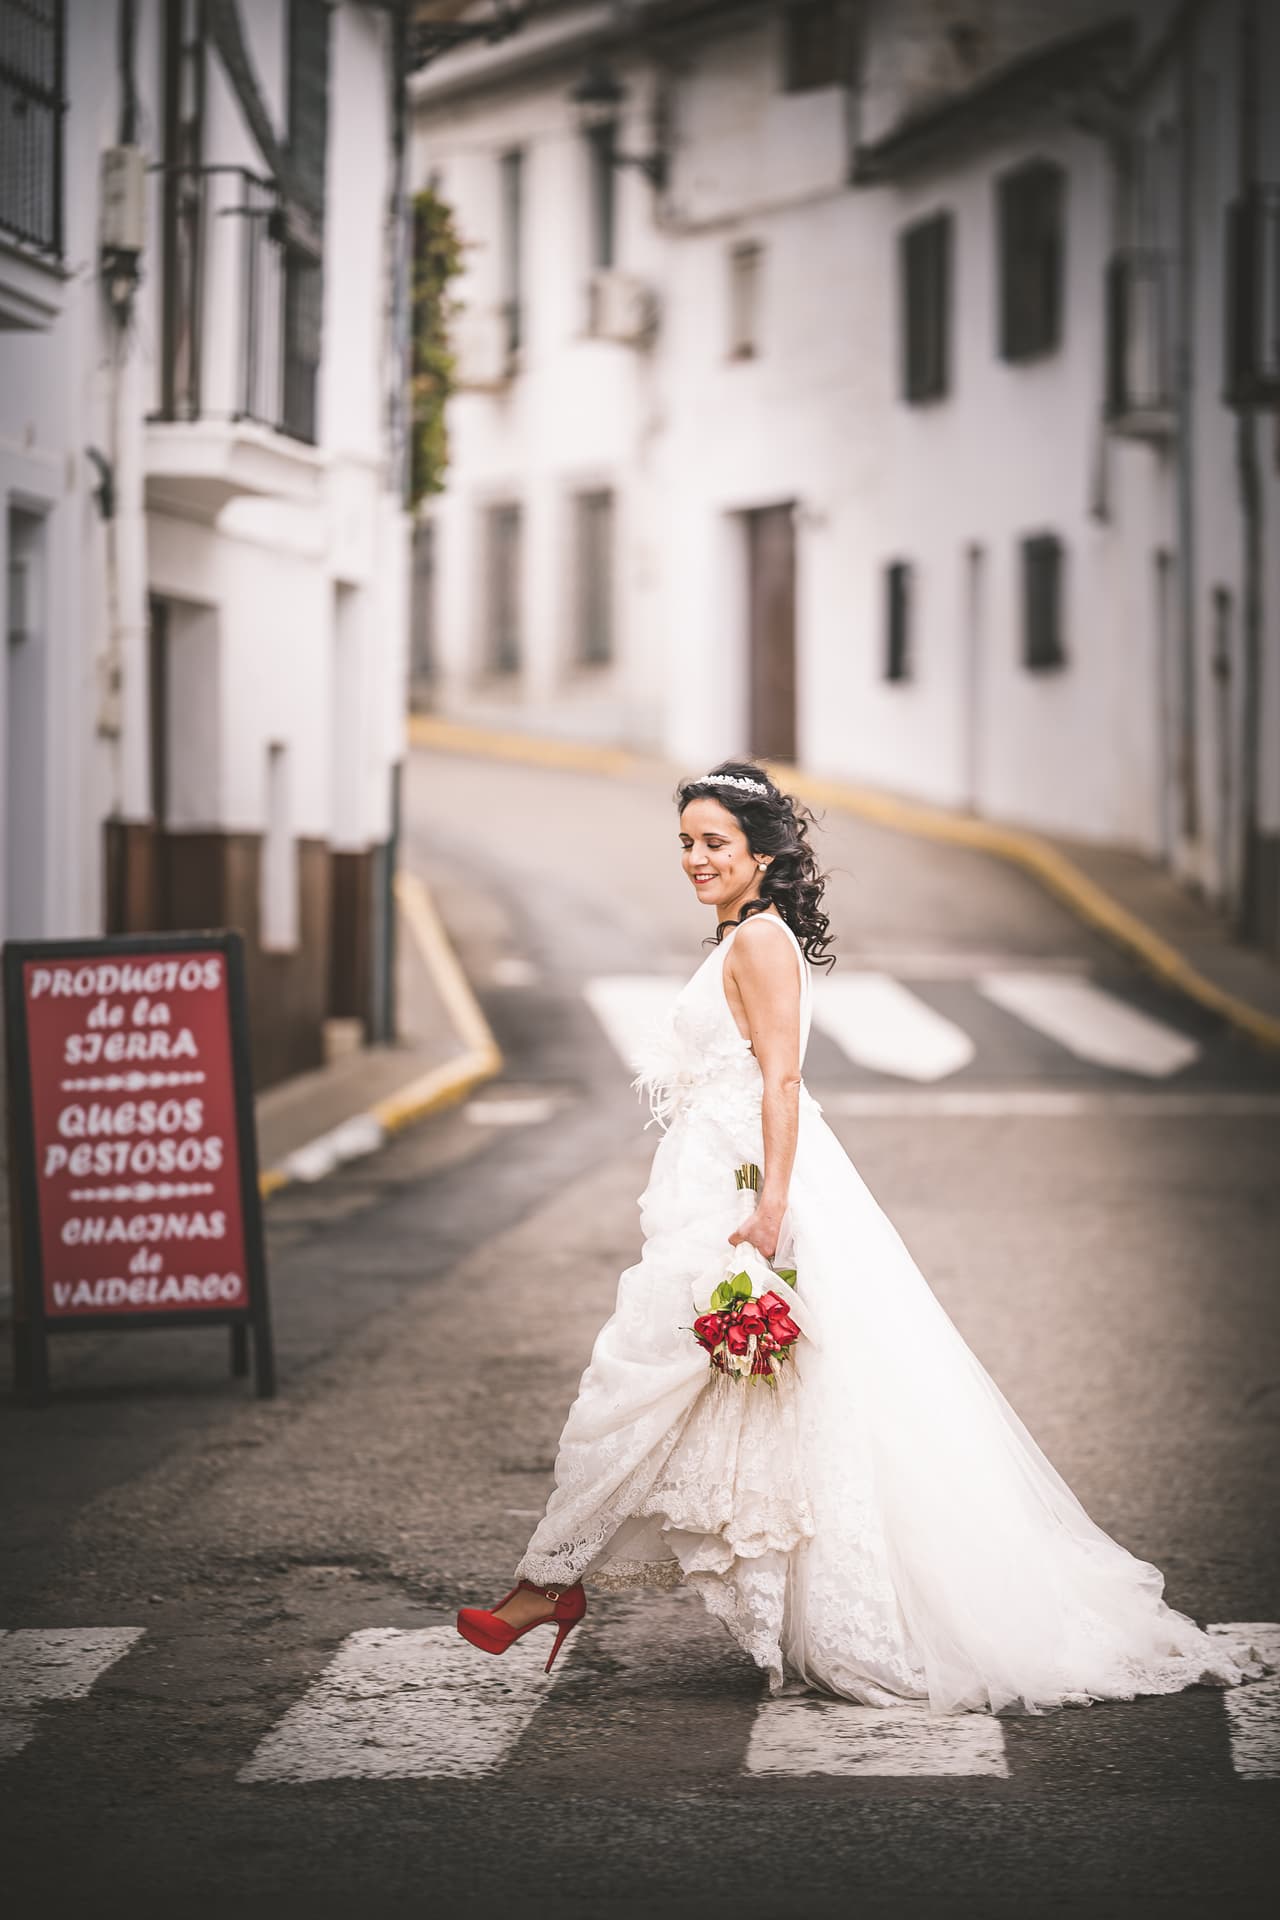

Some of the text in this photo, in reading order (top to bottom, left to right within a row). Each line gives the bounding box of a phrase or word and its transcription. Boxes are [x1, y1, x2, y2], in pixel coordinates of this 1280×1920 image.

[31, 959, 221, 998] PRODUCTOS
[64, 1028, 199, 1065] SIERRA
[58, 1098, 204, 1137] QUESOS
[44, 1136, 223, 1178] PESTOSOS
[61, 1211, 226, 1245] CHACINAS
[53, 1272, 241, 1307] VALDELARCO
